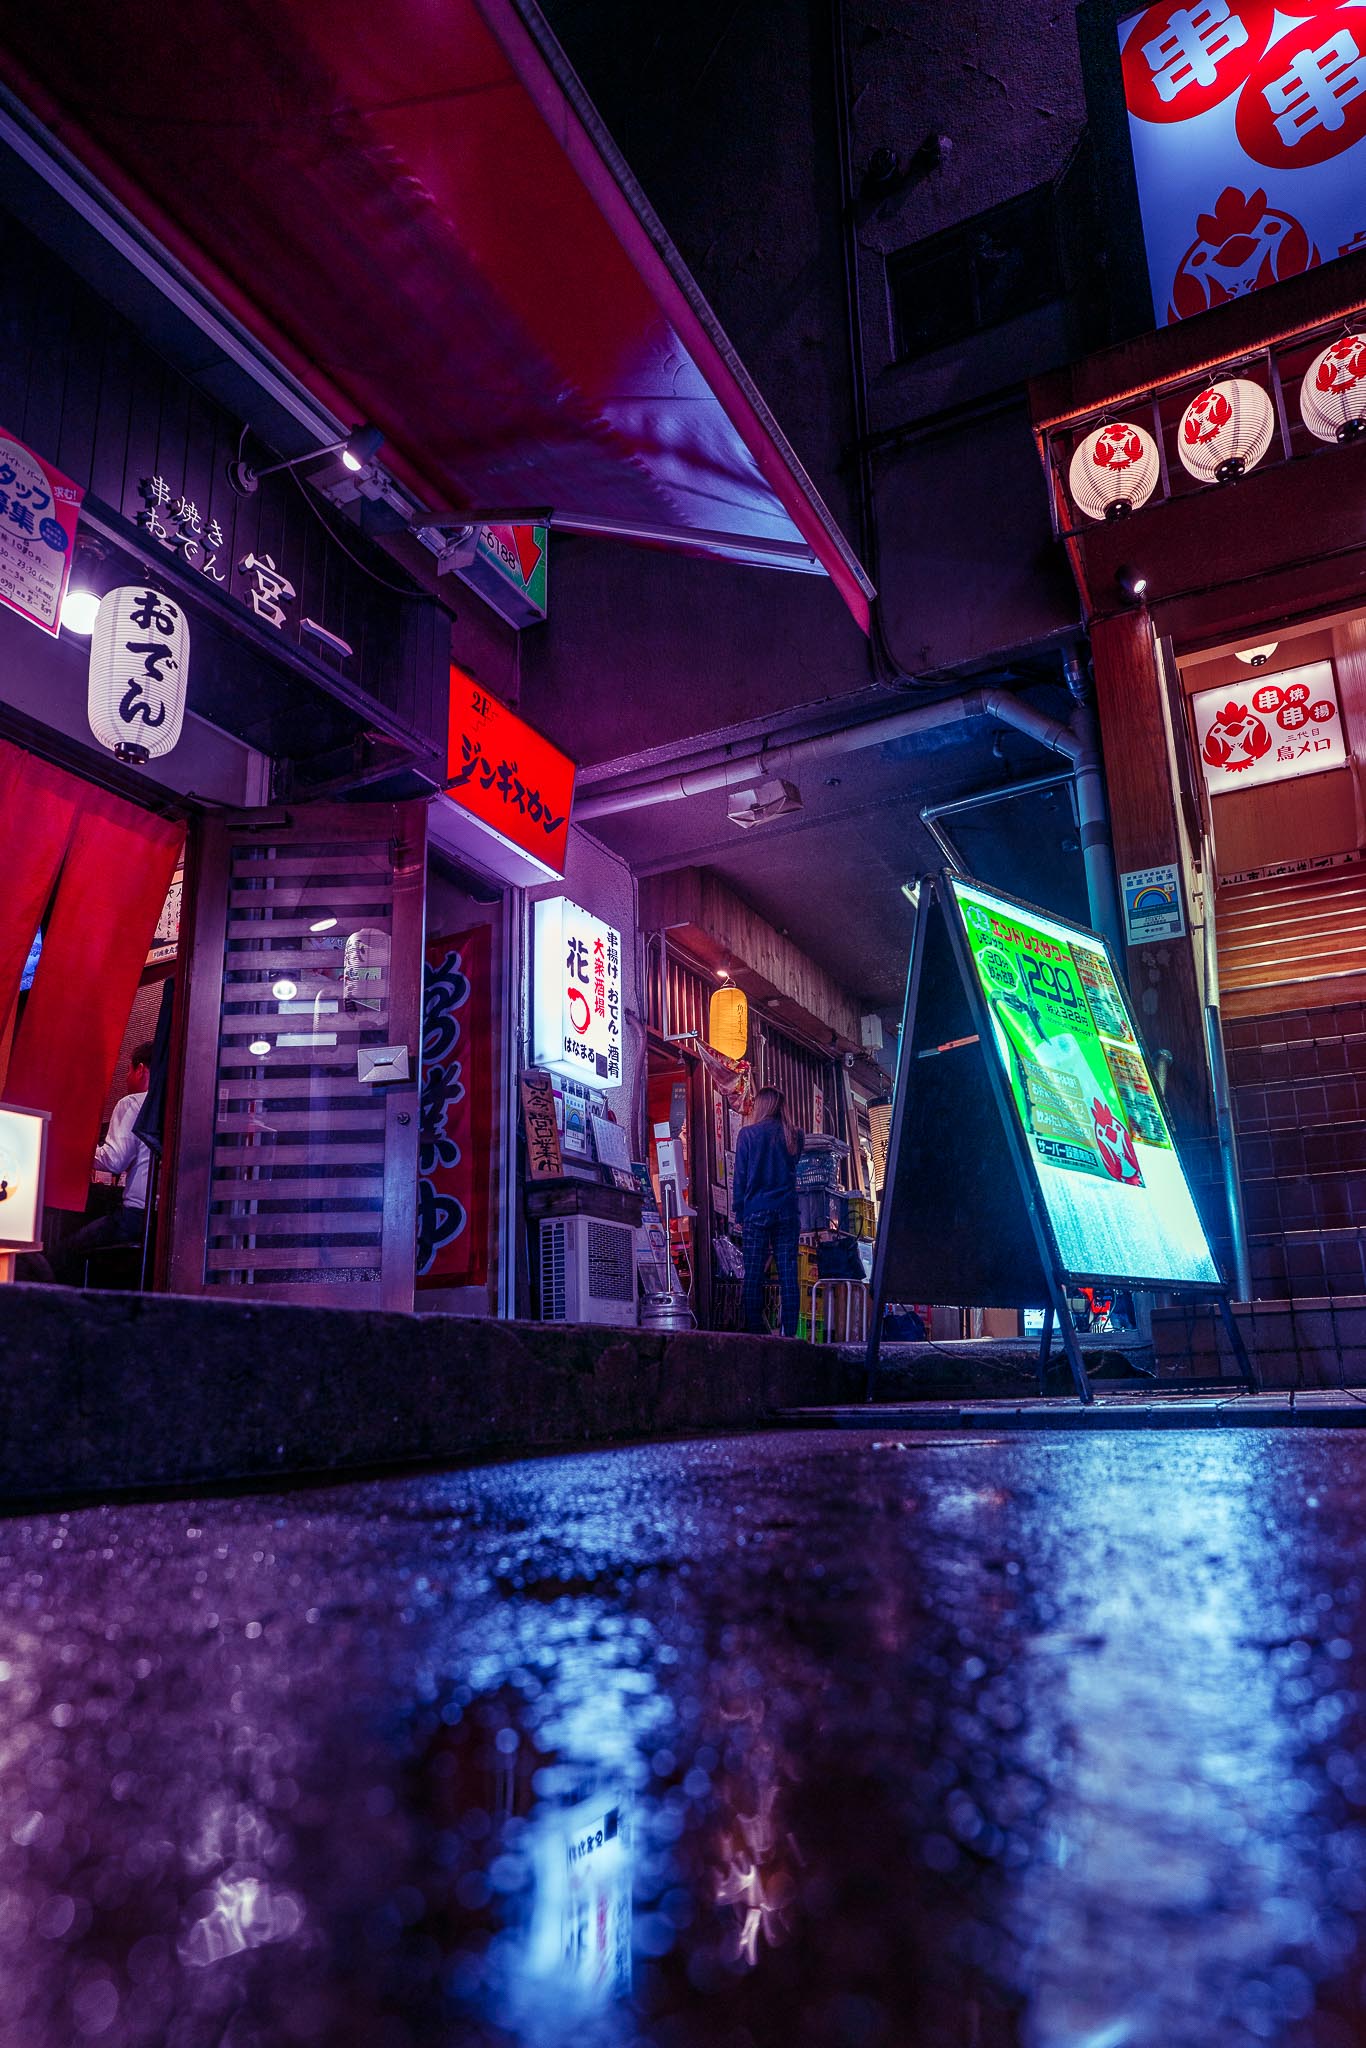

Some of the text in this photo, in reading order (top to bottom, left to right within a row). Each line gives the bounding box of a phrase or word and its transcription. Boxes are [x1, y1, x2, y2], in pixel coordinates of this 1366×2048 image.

[1141, 0, 1249, 102] 串
[1261, 29, 1366, 146] 串
[146, 506, 226, 581] おでん
[151, 475, 223, 549] 串焼き
[118, 590, 178, 728] おでん
[1259, 687, 1305, 710] 串焼
[1283, 704, 1330, 726] 串揚
[1285, 728, 1320, 743] 三代目
[461, 733, 567, 834] ジンギスカン
[1277, 738, 1331, 762] 鳥メロ
[990, 918, 1072, 962] エンドレスサワー
[593, 937, 606, 1019] 大衆酒場
[564, 1036, 595, 1063] はなまる
